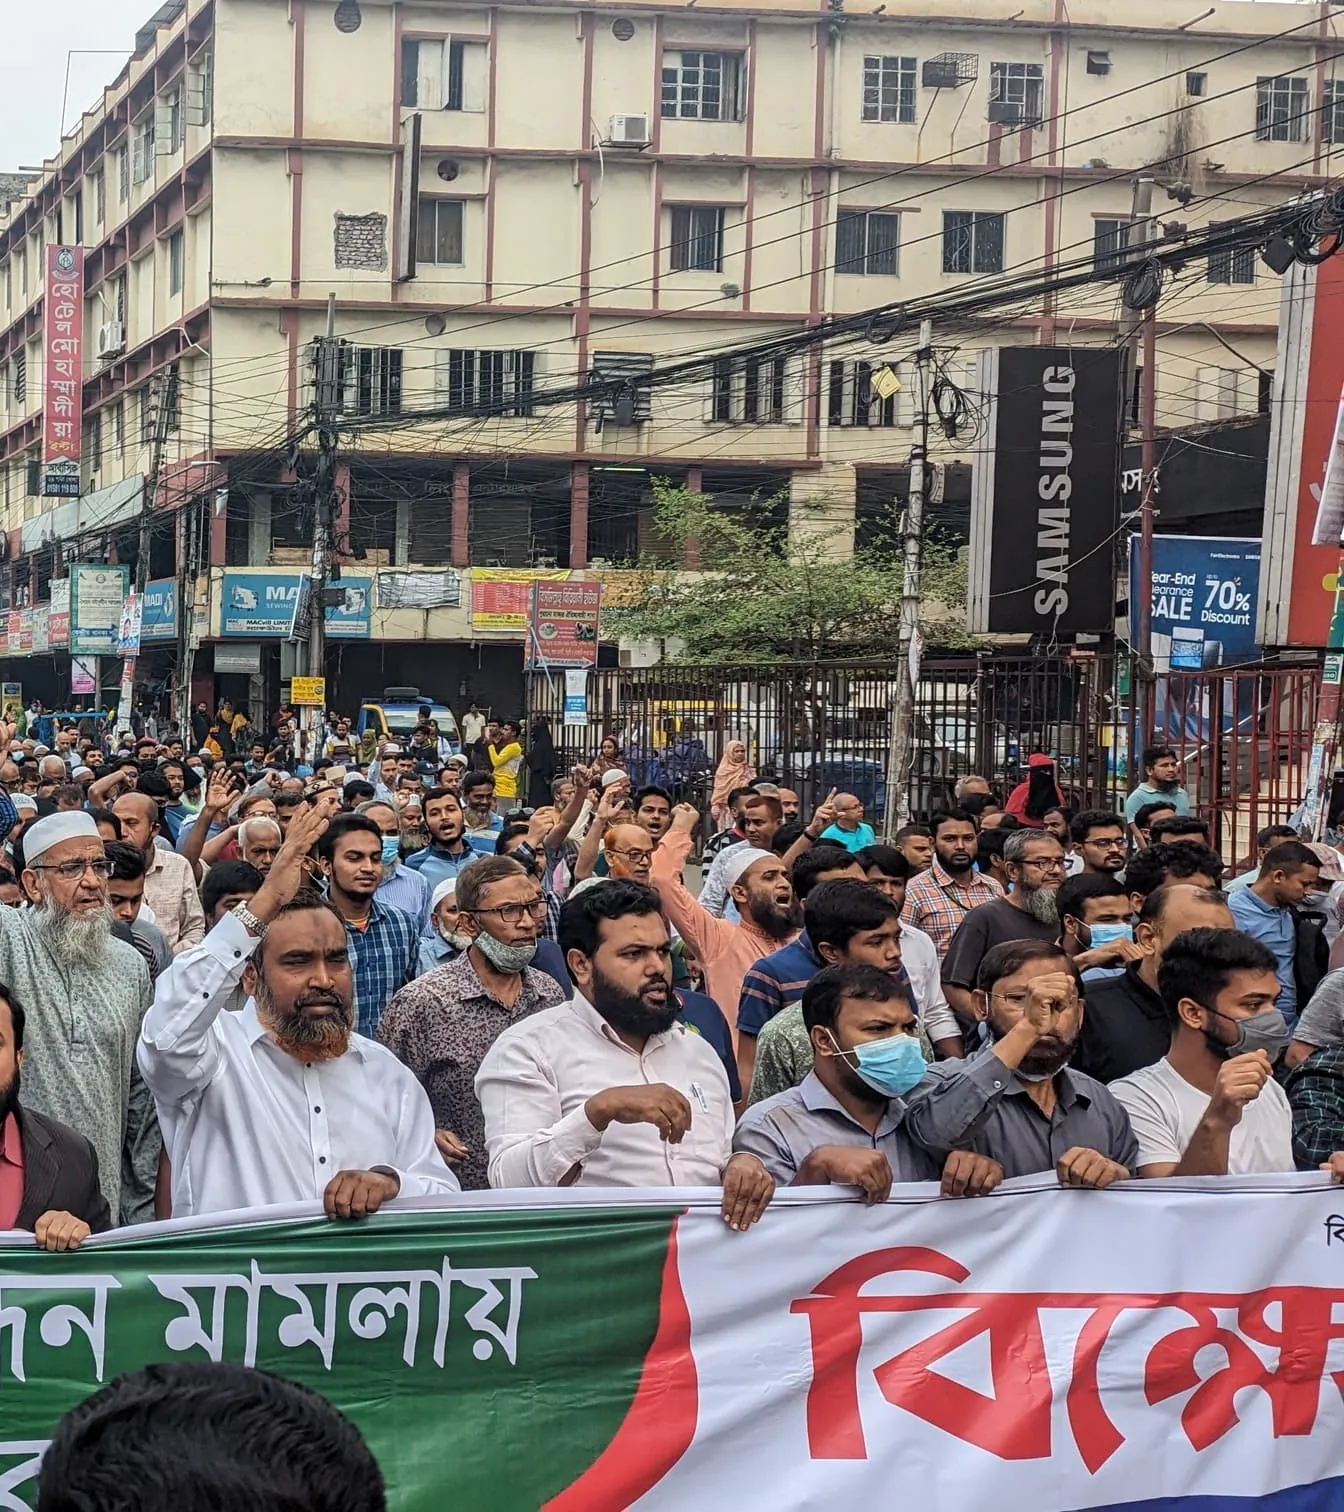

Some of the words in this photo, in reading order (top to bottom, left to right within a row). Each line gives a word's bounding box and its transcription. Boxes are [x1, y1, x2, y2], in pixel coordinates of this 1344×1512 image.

[1034, 365, 1076, 616] SAMSUNG
[1151, 570, 1196, 586] ear-End
[266, 586, 298, 600] MA
[1151, 585, 1194, 597] learance
[1204, 578, 1251, 612] 70%
[1201, 610, 1251, 625] Discount
[147, 1255, 538, 1371] মামলায়
